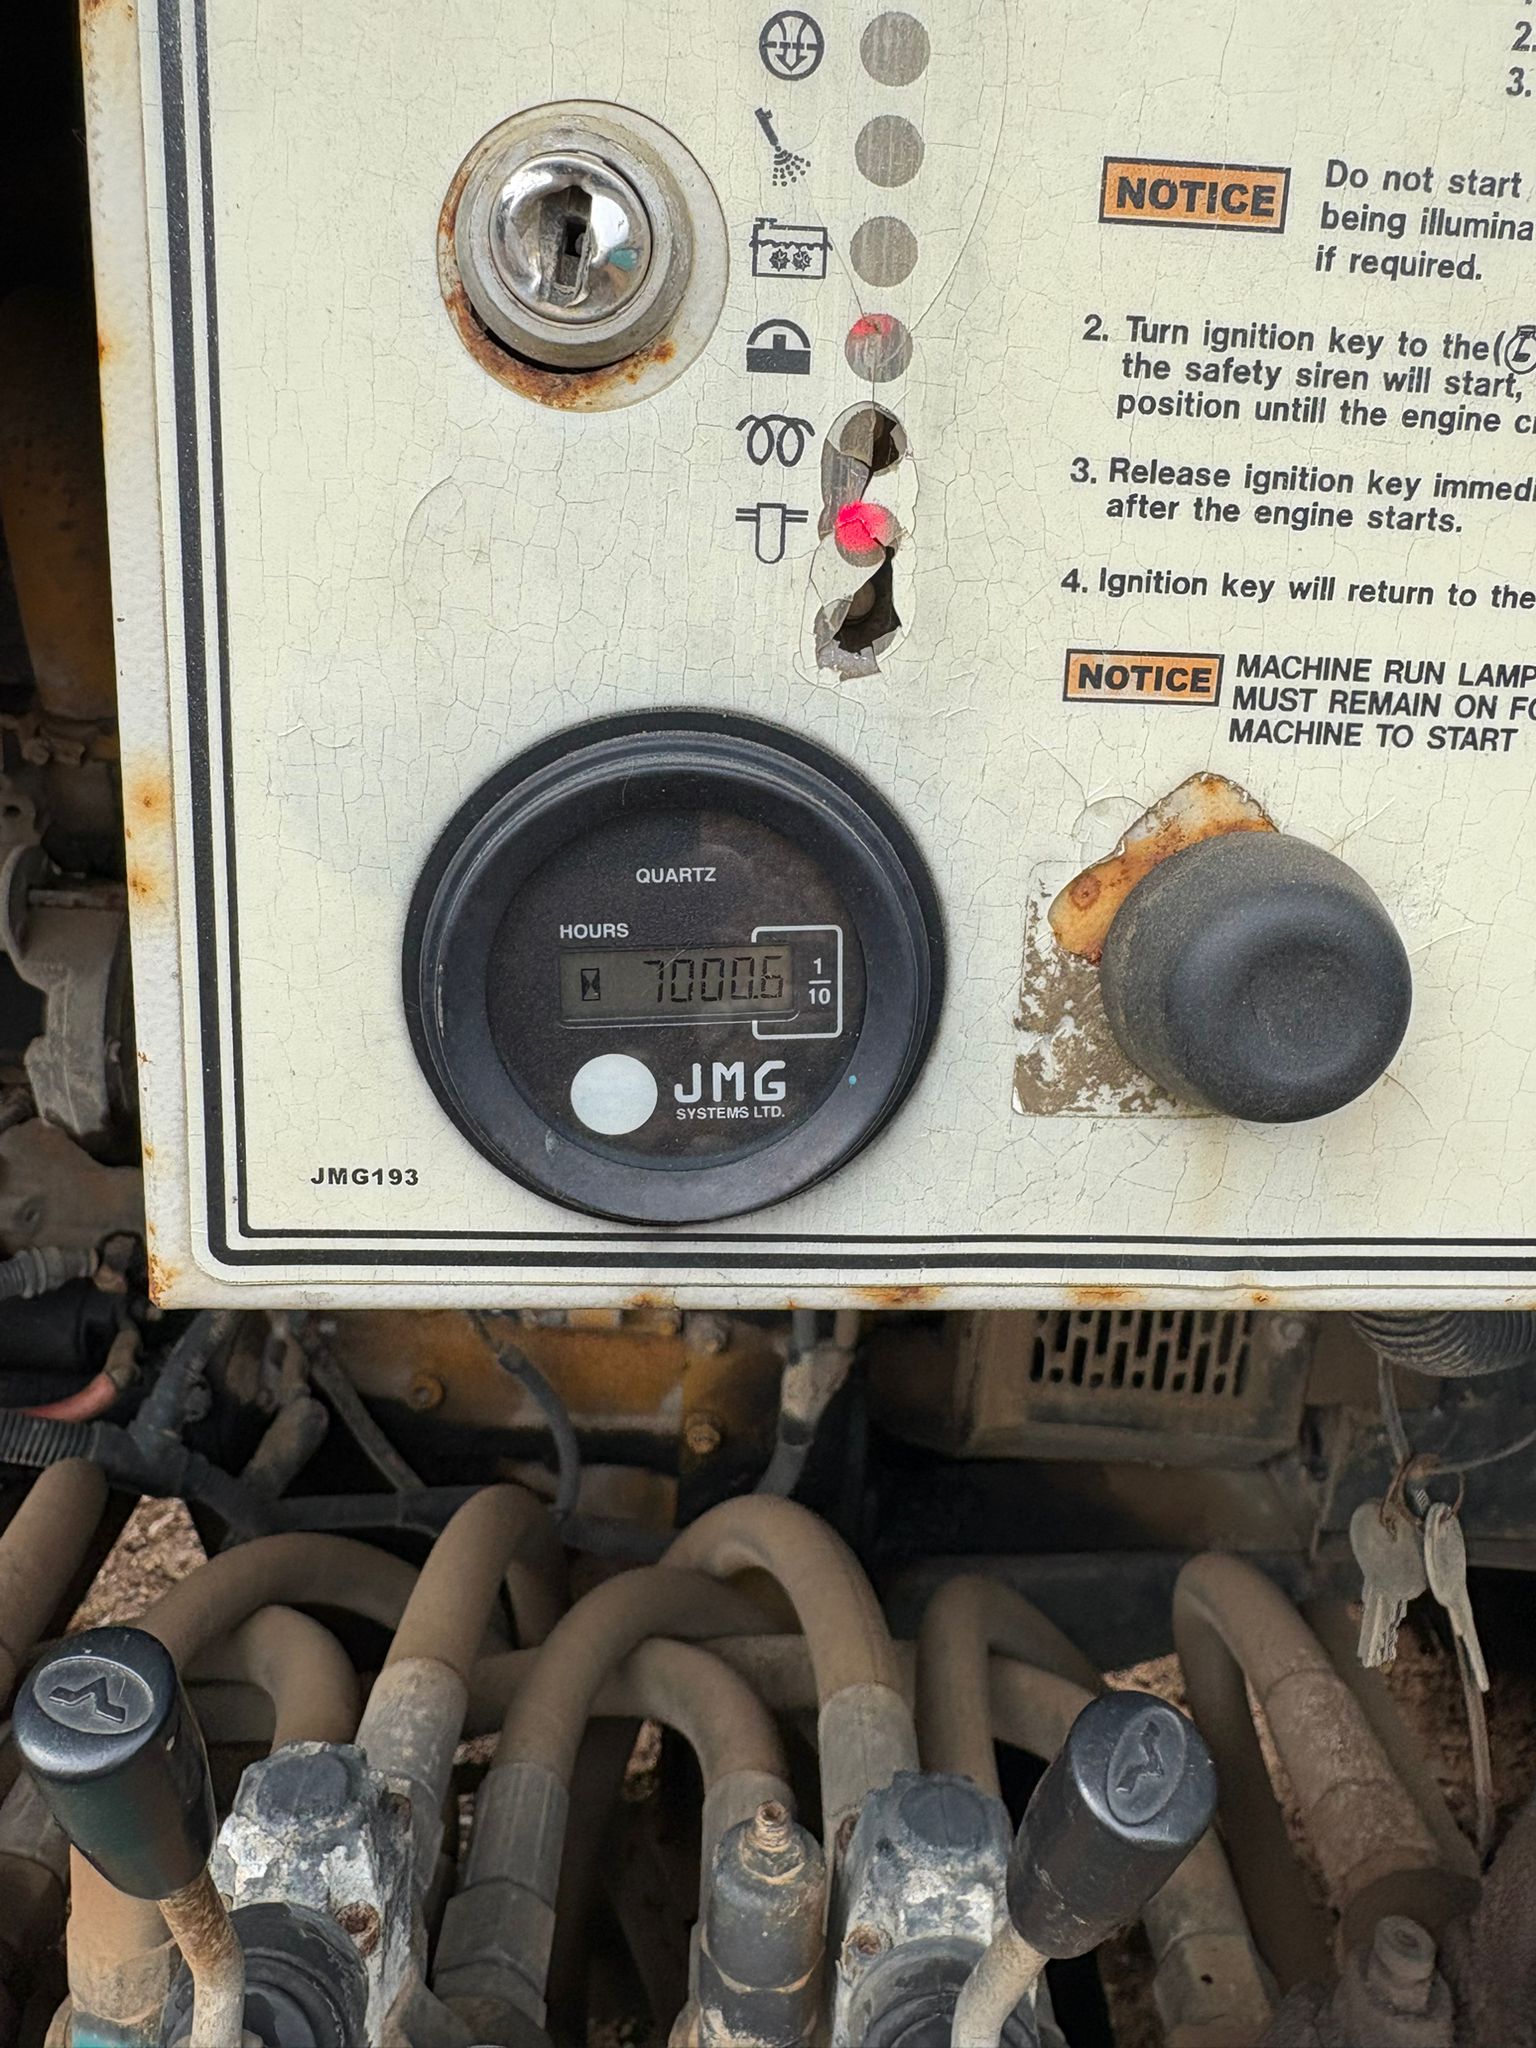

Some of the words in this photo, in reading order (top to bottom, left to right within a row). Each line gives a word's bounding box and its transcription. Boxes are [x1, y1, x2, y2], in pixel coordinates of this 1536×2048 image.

[1506, 66, 1531, 97] 3.
[1325, 159, 1368, 189] Do
[1382, 167, 1433, 194] not
[1448, 169, 1522, 198] start
[1116, 176, 1277, 217] NOTICE
[1321, 202, 1407, 239] being
[1420, 207, 1533, 242] illumina
[1315, 245, 1336, 272] if
[1349, 250, 1483, 281] required.
[1082, 314, 1109, 341] 2.
[1126, 315, 1189, 345] Turn
[1203, 320, 1314, 352] ignition
[1329, 326, 1384, 360] key
[1398, 331, 1427, 358] to
[1122, 353, 1170, 380] the
[1185, 358, 1282, 391] safety
[1295, 362, 1369, 390] siren
[1384, 366, 1431, 394] will
[1444, 371, 1523, 403] start,
[1116, 391, 1240, 420] position
[1255, 397, 1325, 423] untill
[1340, 400, 1387, 426] the
[1401, 407, 1501, 435] engine
[1070, 457, 1097, 484] 3.
[1109, 458, 1230, 487] Release
[1244, 464, 1353, 494] ignition
[1367, 470, 1421, 502] key
[1106, 494, 1180, 520] after
[1193, 499, 1240, 523] the
[1255, 504, 1353, 530] engine
[1367, 507, 1463, 533] starts.
[1061, 569, 1088, 593] 4.
[1099, 568, 1208, 598] Ignition
[1221, 573, 1275, 602] key
[1289, 576, 1335, 601] will
[1348, 584, 1434, 605] return
[1448, 583, 1477, 606] to
[1491, 585, 1536, 609] the
[1078, 663, 1212, 693] NOTICE
[1236, 654, 1372, 683] MACHINE
[1384, 659, 1446, 685] RUN
[1458, 662, 1536, 688] LAMP
[1233, 686, 1317, 712] MUST
[1329, 690, 1441, 718] REMAIN
[1454, 695, 1498, 720] ON
[1229, 719, 1363, 747] MACHINE
[1376, 723, 1414, 748] TO
[1426, 726, 1518, 751] START
[635, 867, 717, 884] QUARTZ
[559, 923, 629, 939] HOURS
[813, 958, 823, 975] 1
[808, 988, 831, 1005] 10
[674, 1060, 786, 1104] JMG
[676, 1106, 749, 1120] SYSTEMS
[753, 1106, 785, 1119] LTD.
[311, 1167, 419, 1186] JMG193
